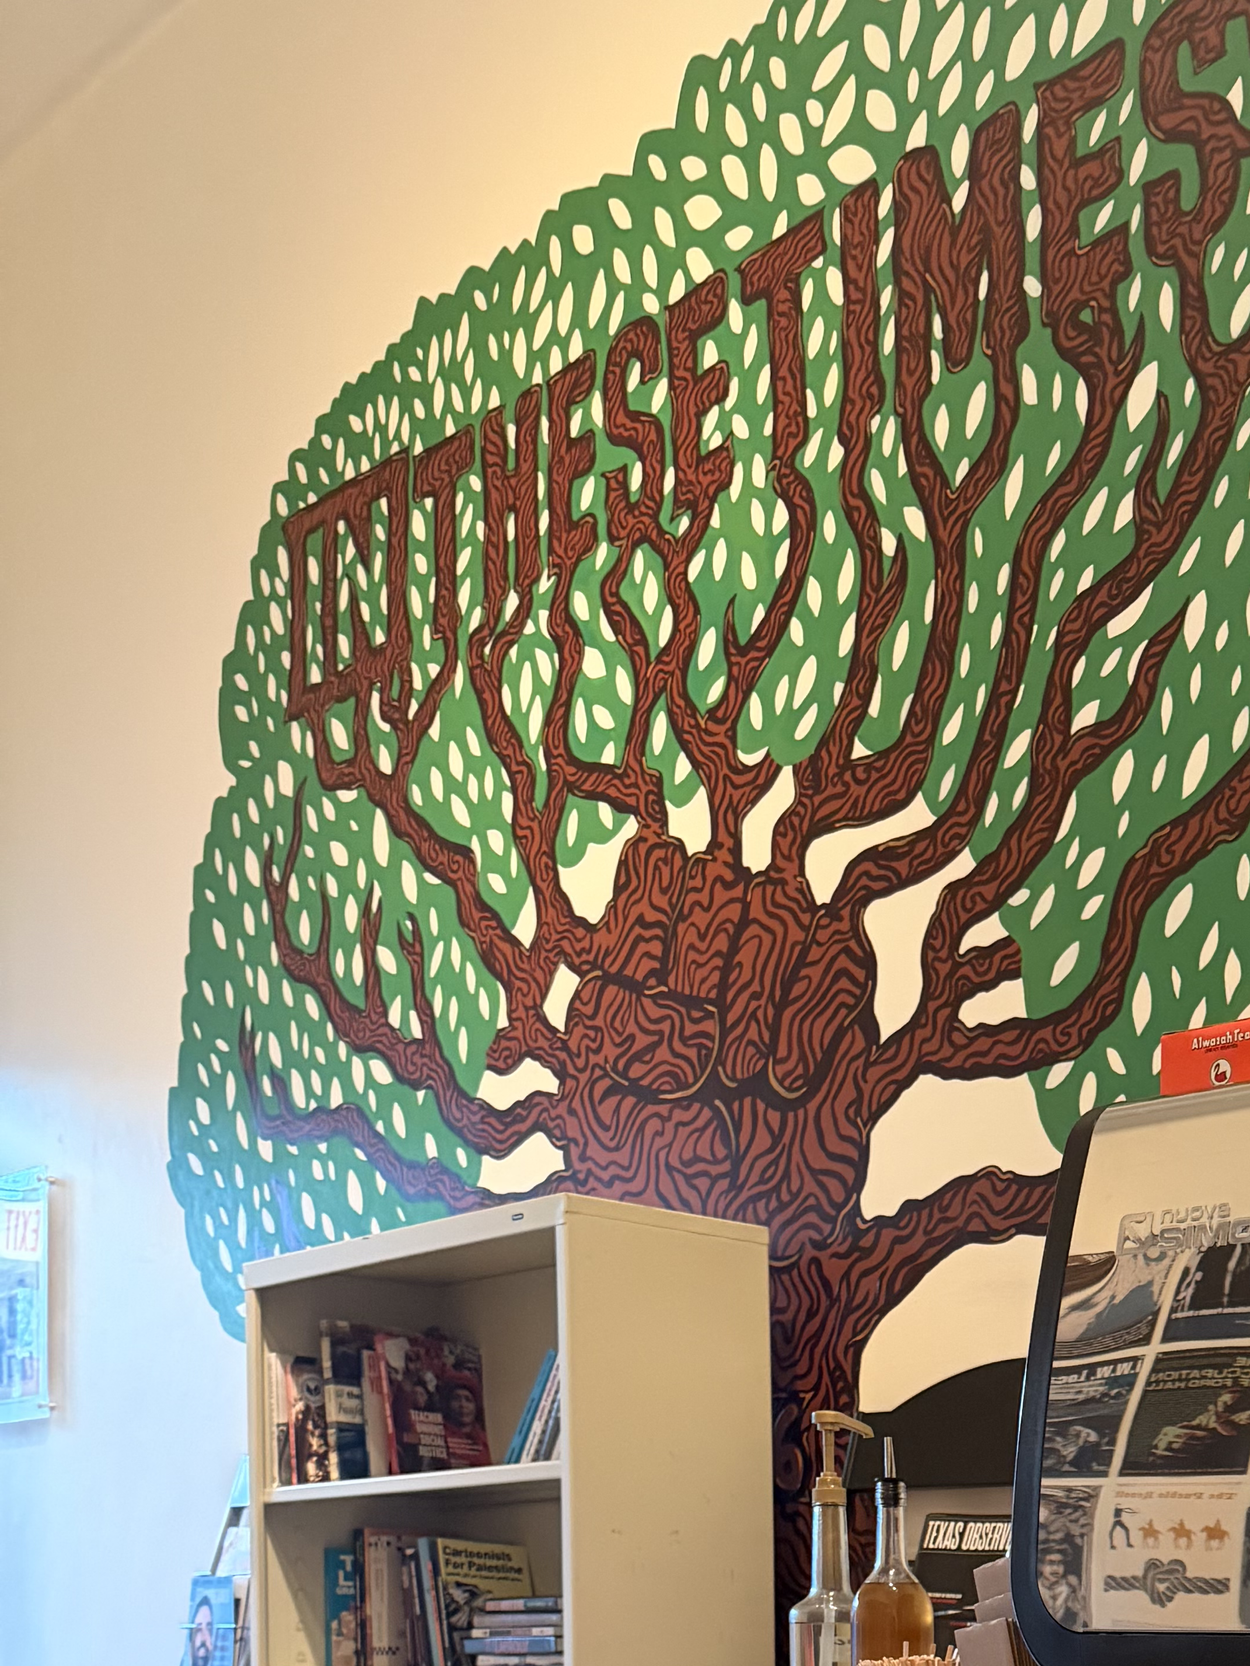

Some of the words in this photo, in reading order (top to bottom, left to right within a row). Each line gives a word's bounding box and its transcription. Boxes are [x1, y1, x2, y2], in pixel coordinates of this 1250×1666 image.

[284, 447, 412, 722] IN
[412, 268, 734, 625] THESE
[1233, 1028, 1250, 1042] Tea
[922, 1521, 964, 1550] TEXAS
[961, 1522, 1013, 1551] OBSERV
[443, 1545, 513, 1562] Cartoonists
[444, 1558, 466, 1570] For
[468, 1560, 524, 1576] Palestine
